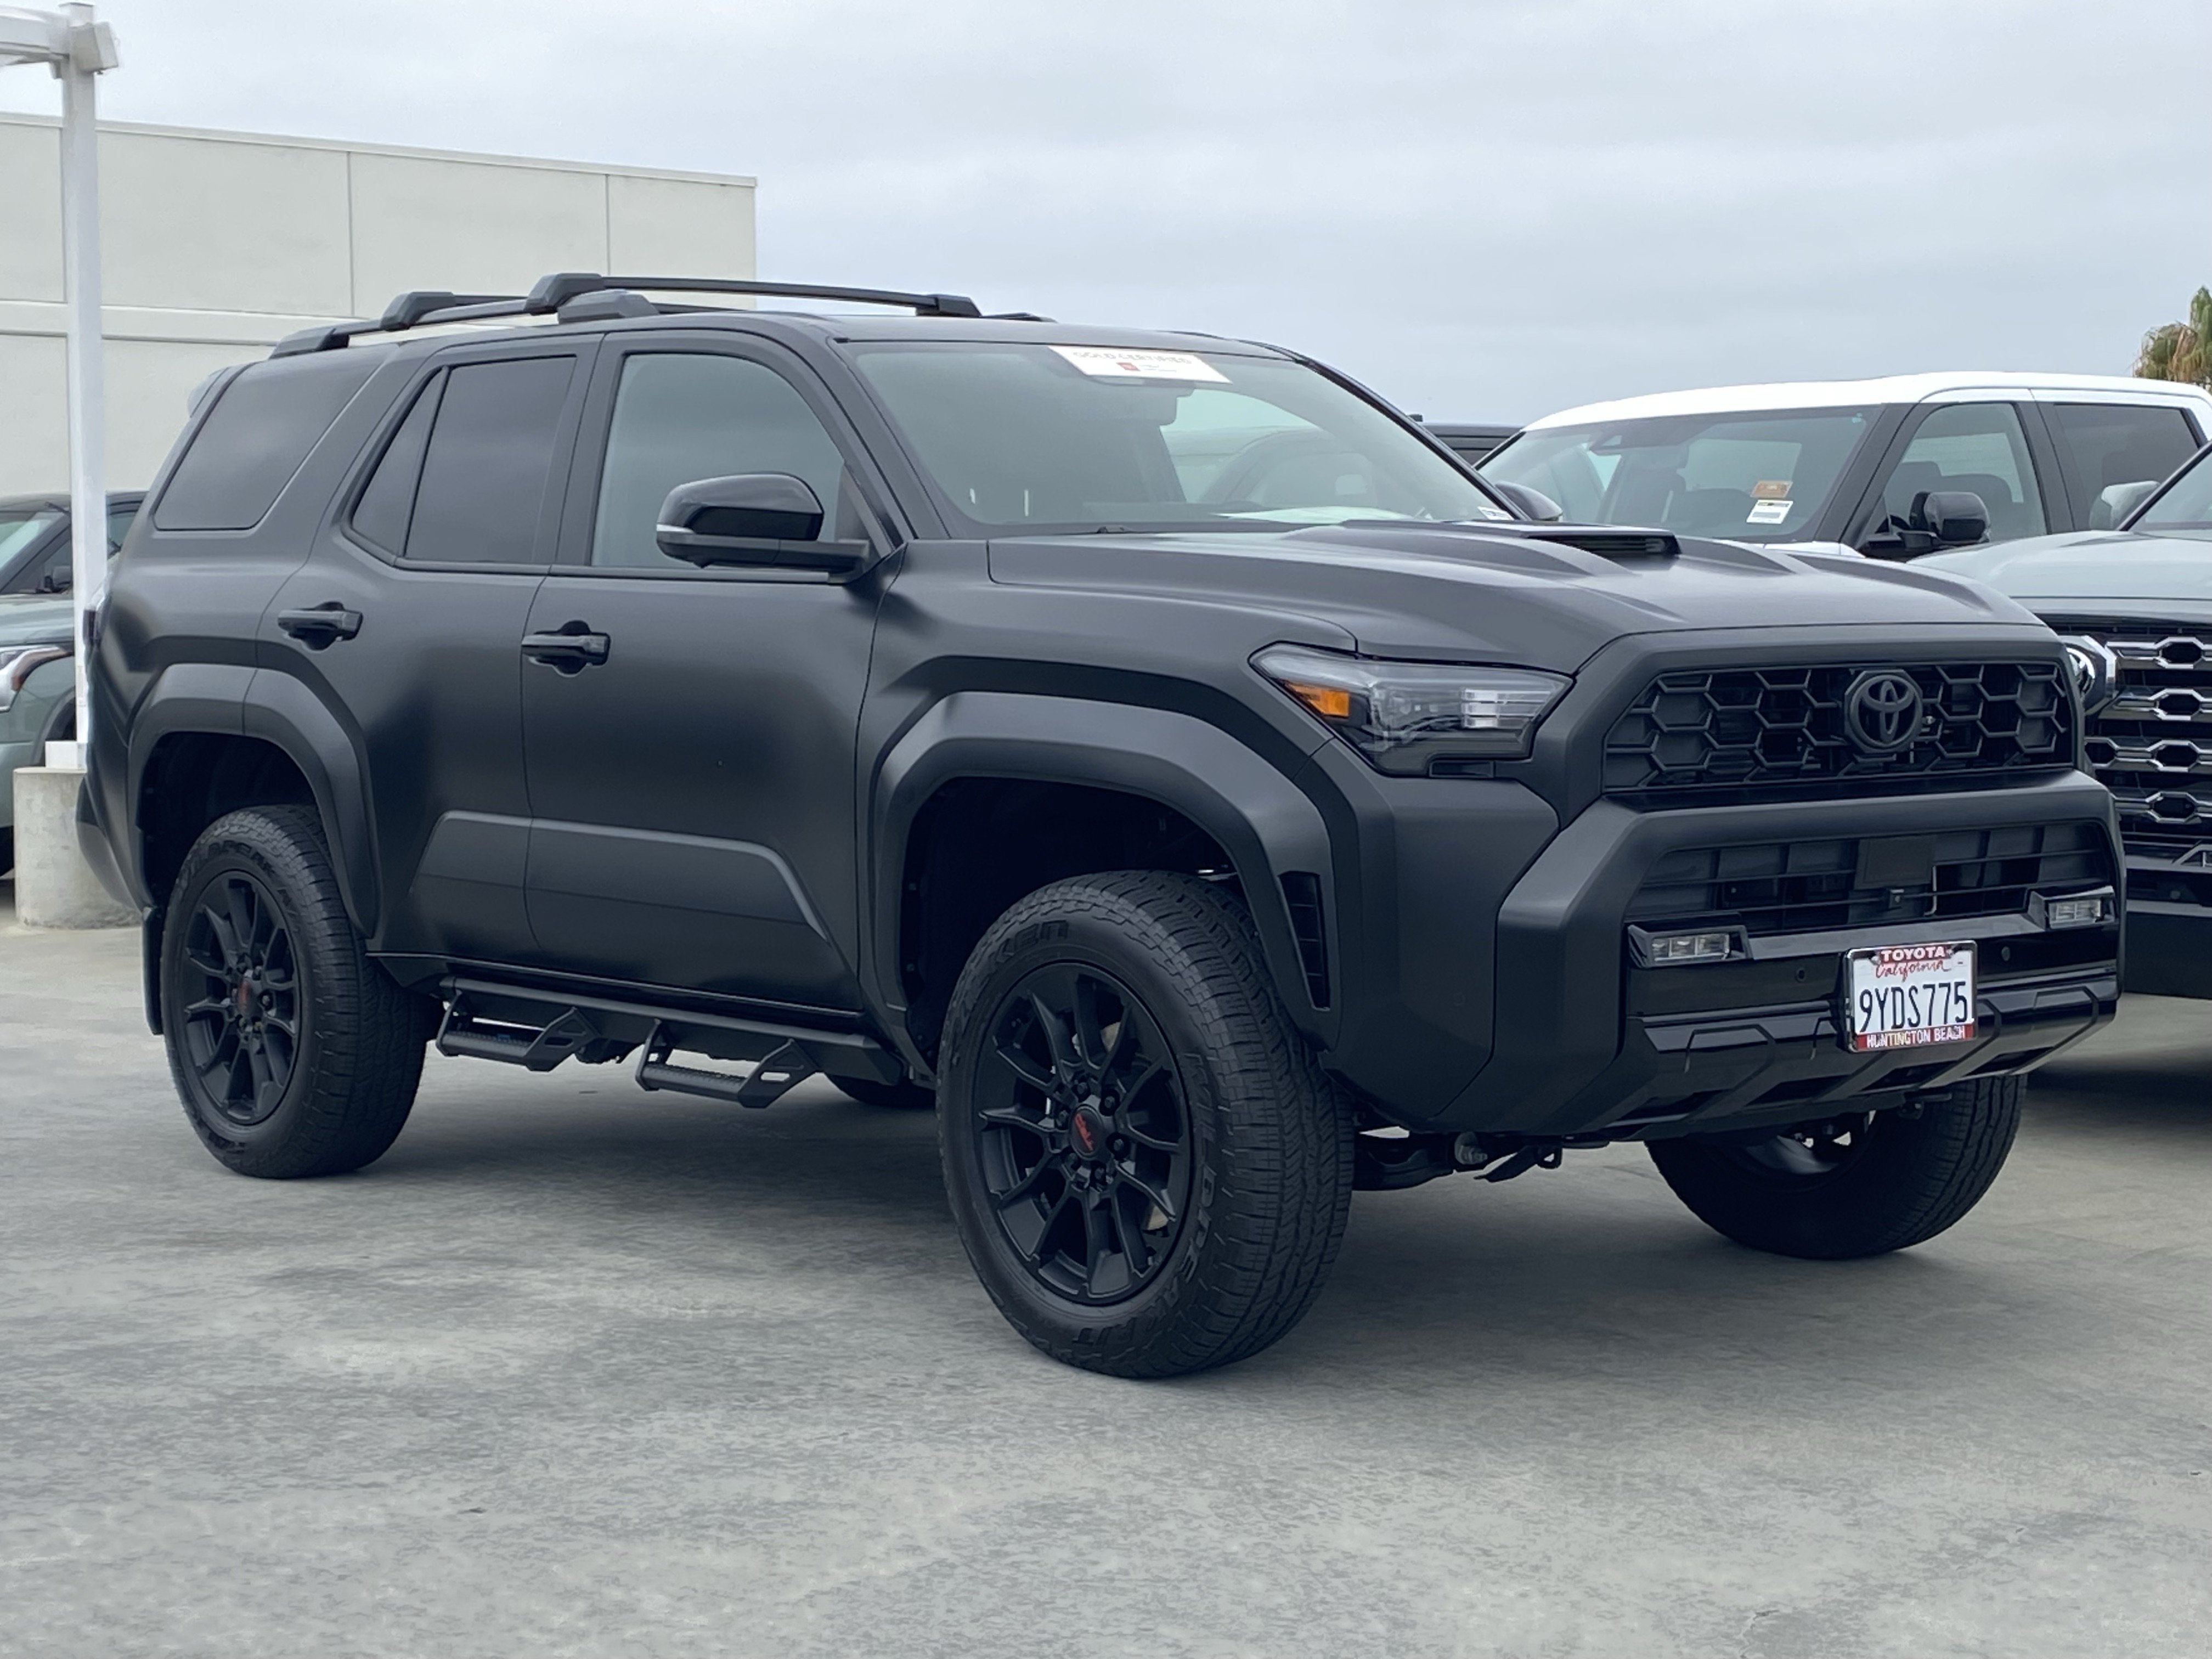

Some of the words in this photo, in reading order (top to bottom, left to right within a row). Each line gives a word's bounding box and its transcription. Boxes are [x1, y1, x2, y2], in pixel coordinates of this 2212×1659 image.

[1881, 946, 1945, 961] TOYOTA
[1875, 959, 1953, 982] California
[1859, 981, 1968, 1032] 9YDS775
[1866, 1028, 1931, 1048] HUNTINGTON
[1934, 1025, 1965, 1041] BEACH
